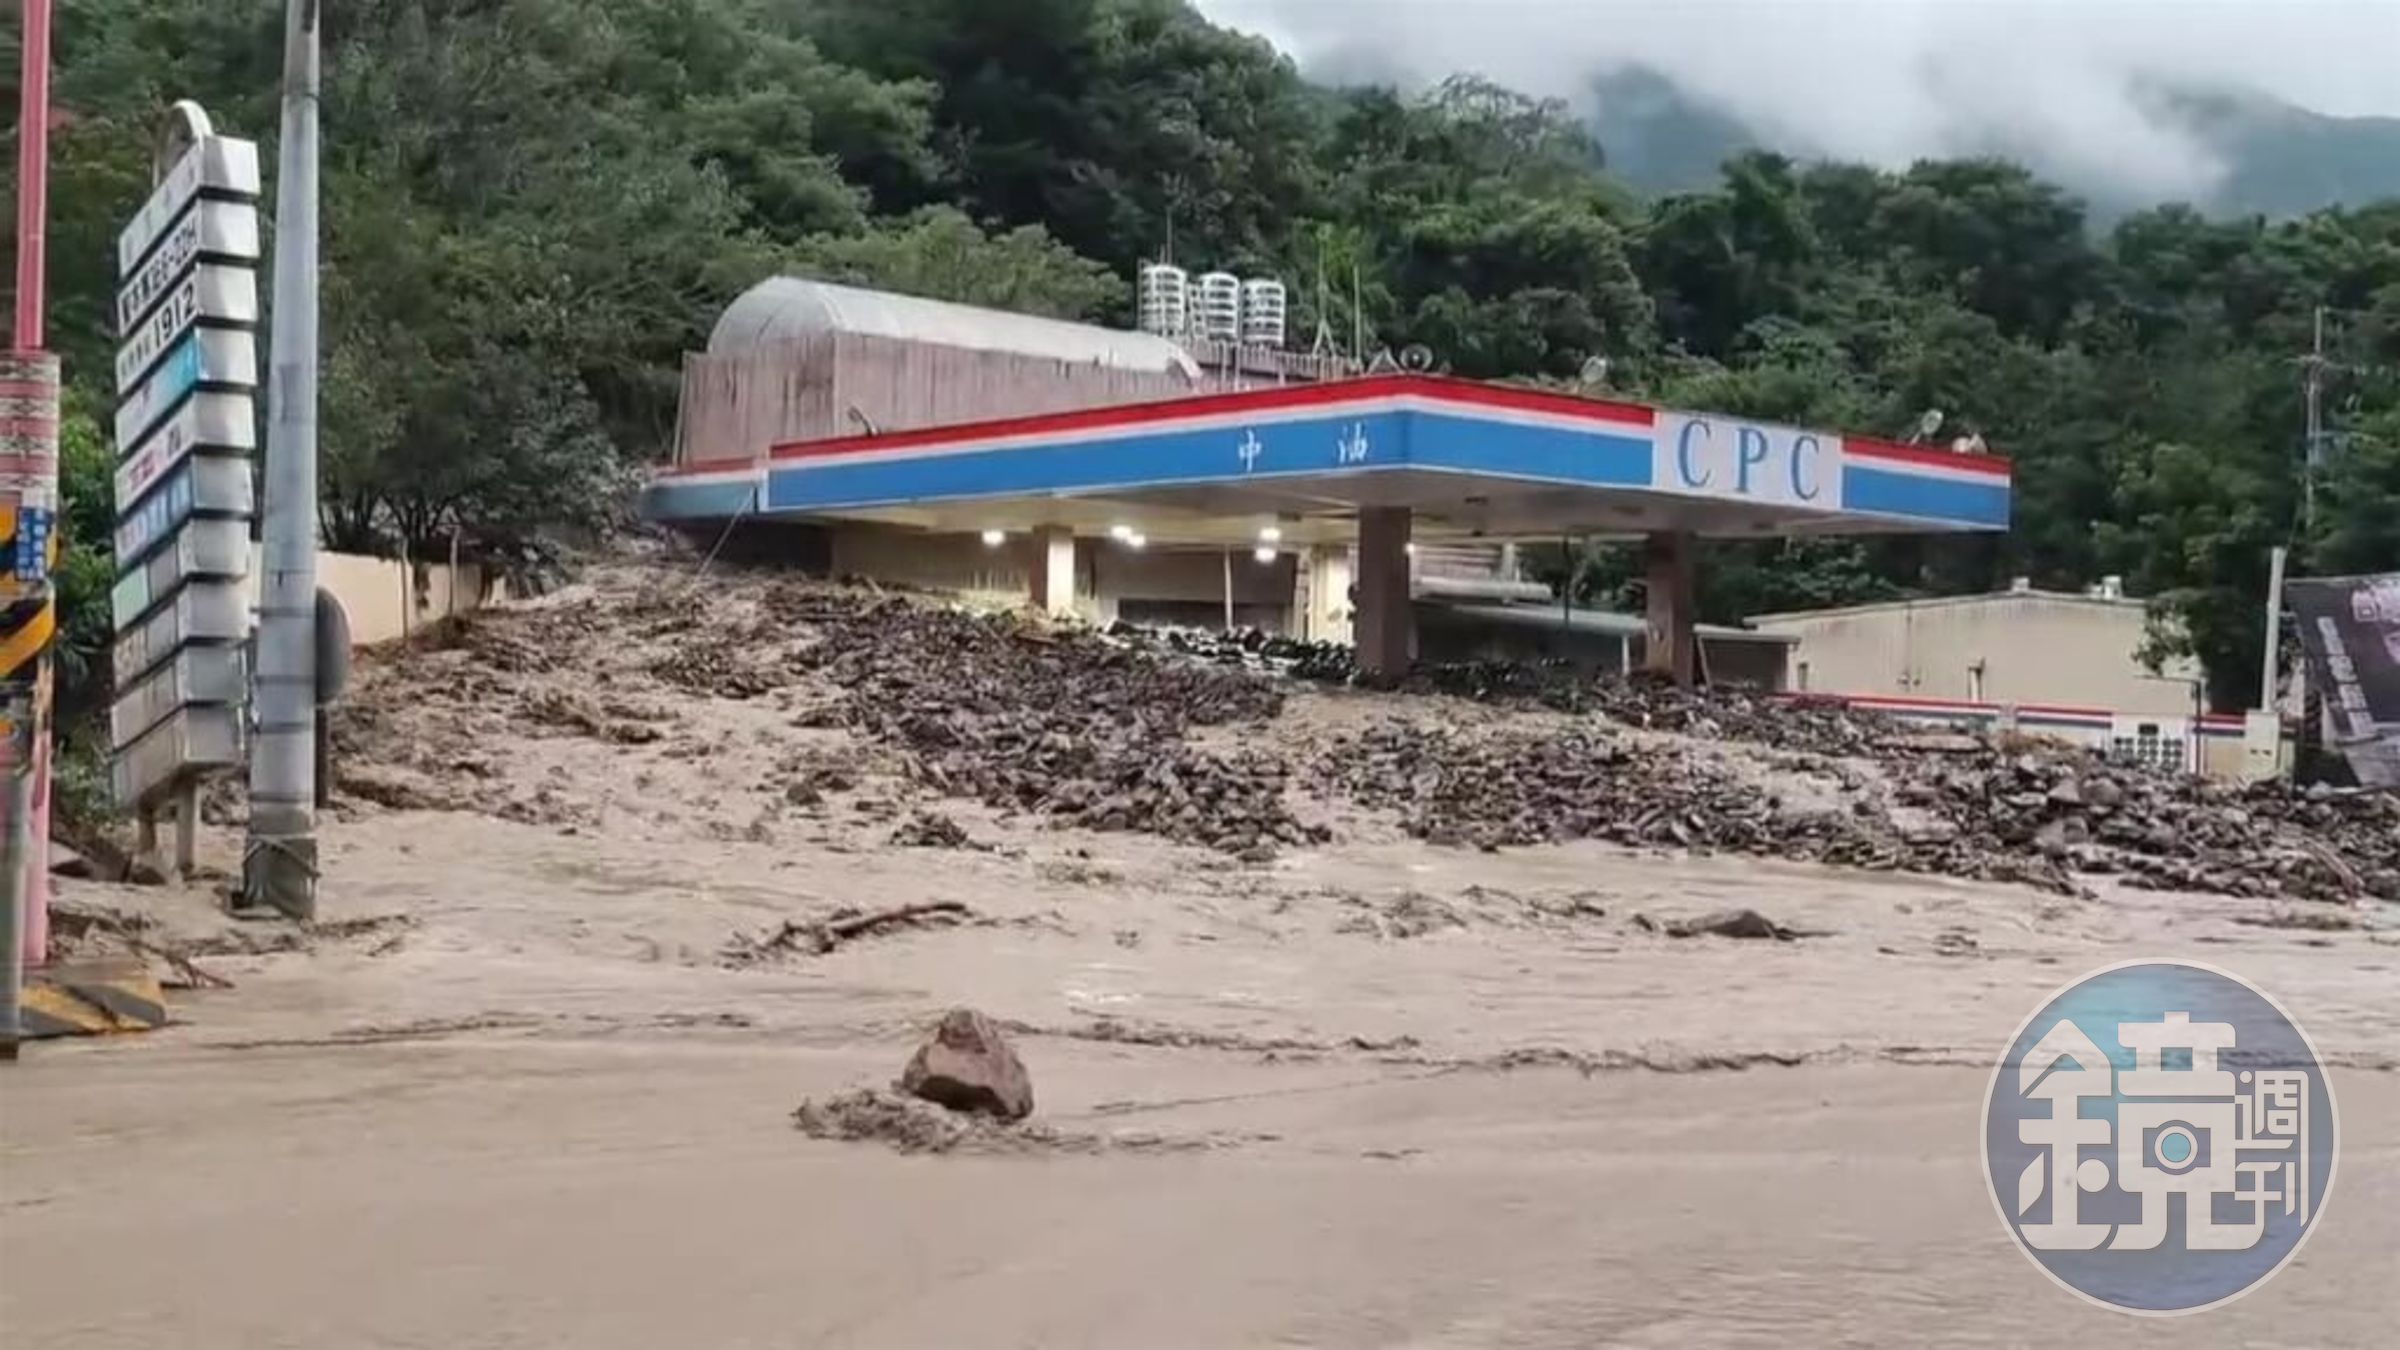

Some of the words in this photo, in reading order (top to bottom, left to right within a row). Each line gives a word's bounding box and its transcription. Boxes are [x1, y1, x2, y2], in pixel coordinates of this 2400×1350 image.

[154, 281, 194, 349] 1912
[1238, 421, 1369, 472] 中油
[1678, 418, 1820, 501] CPC
